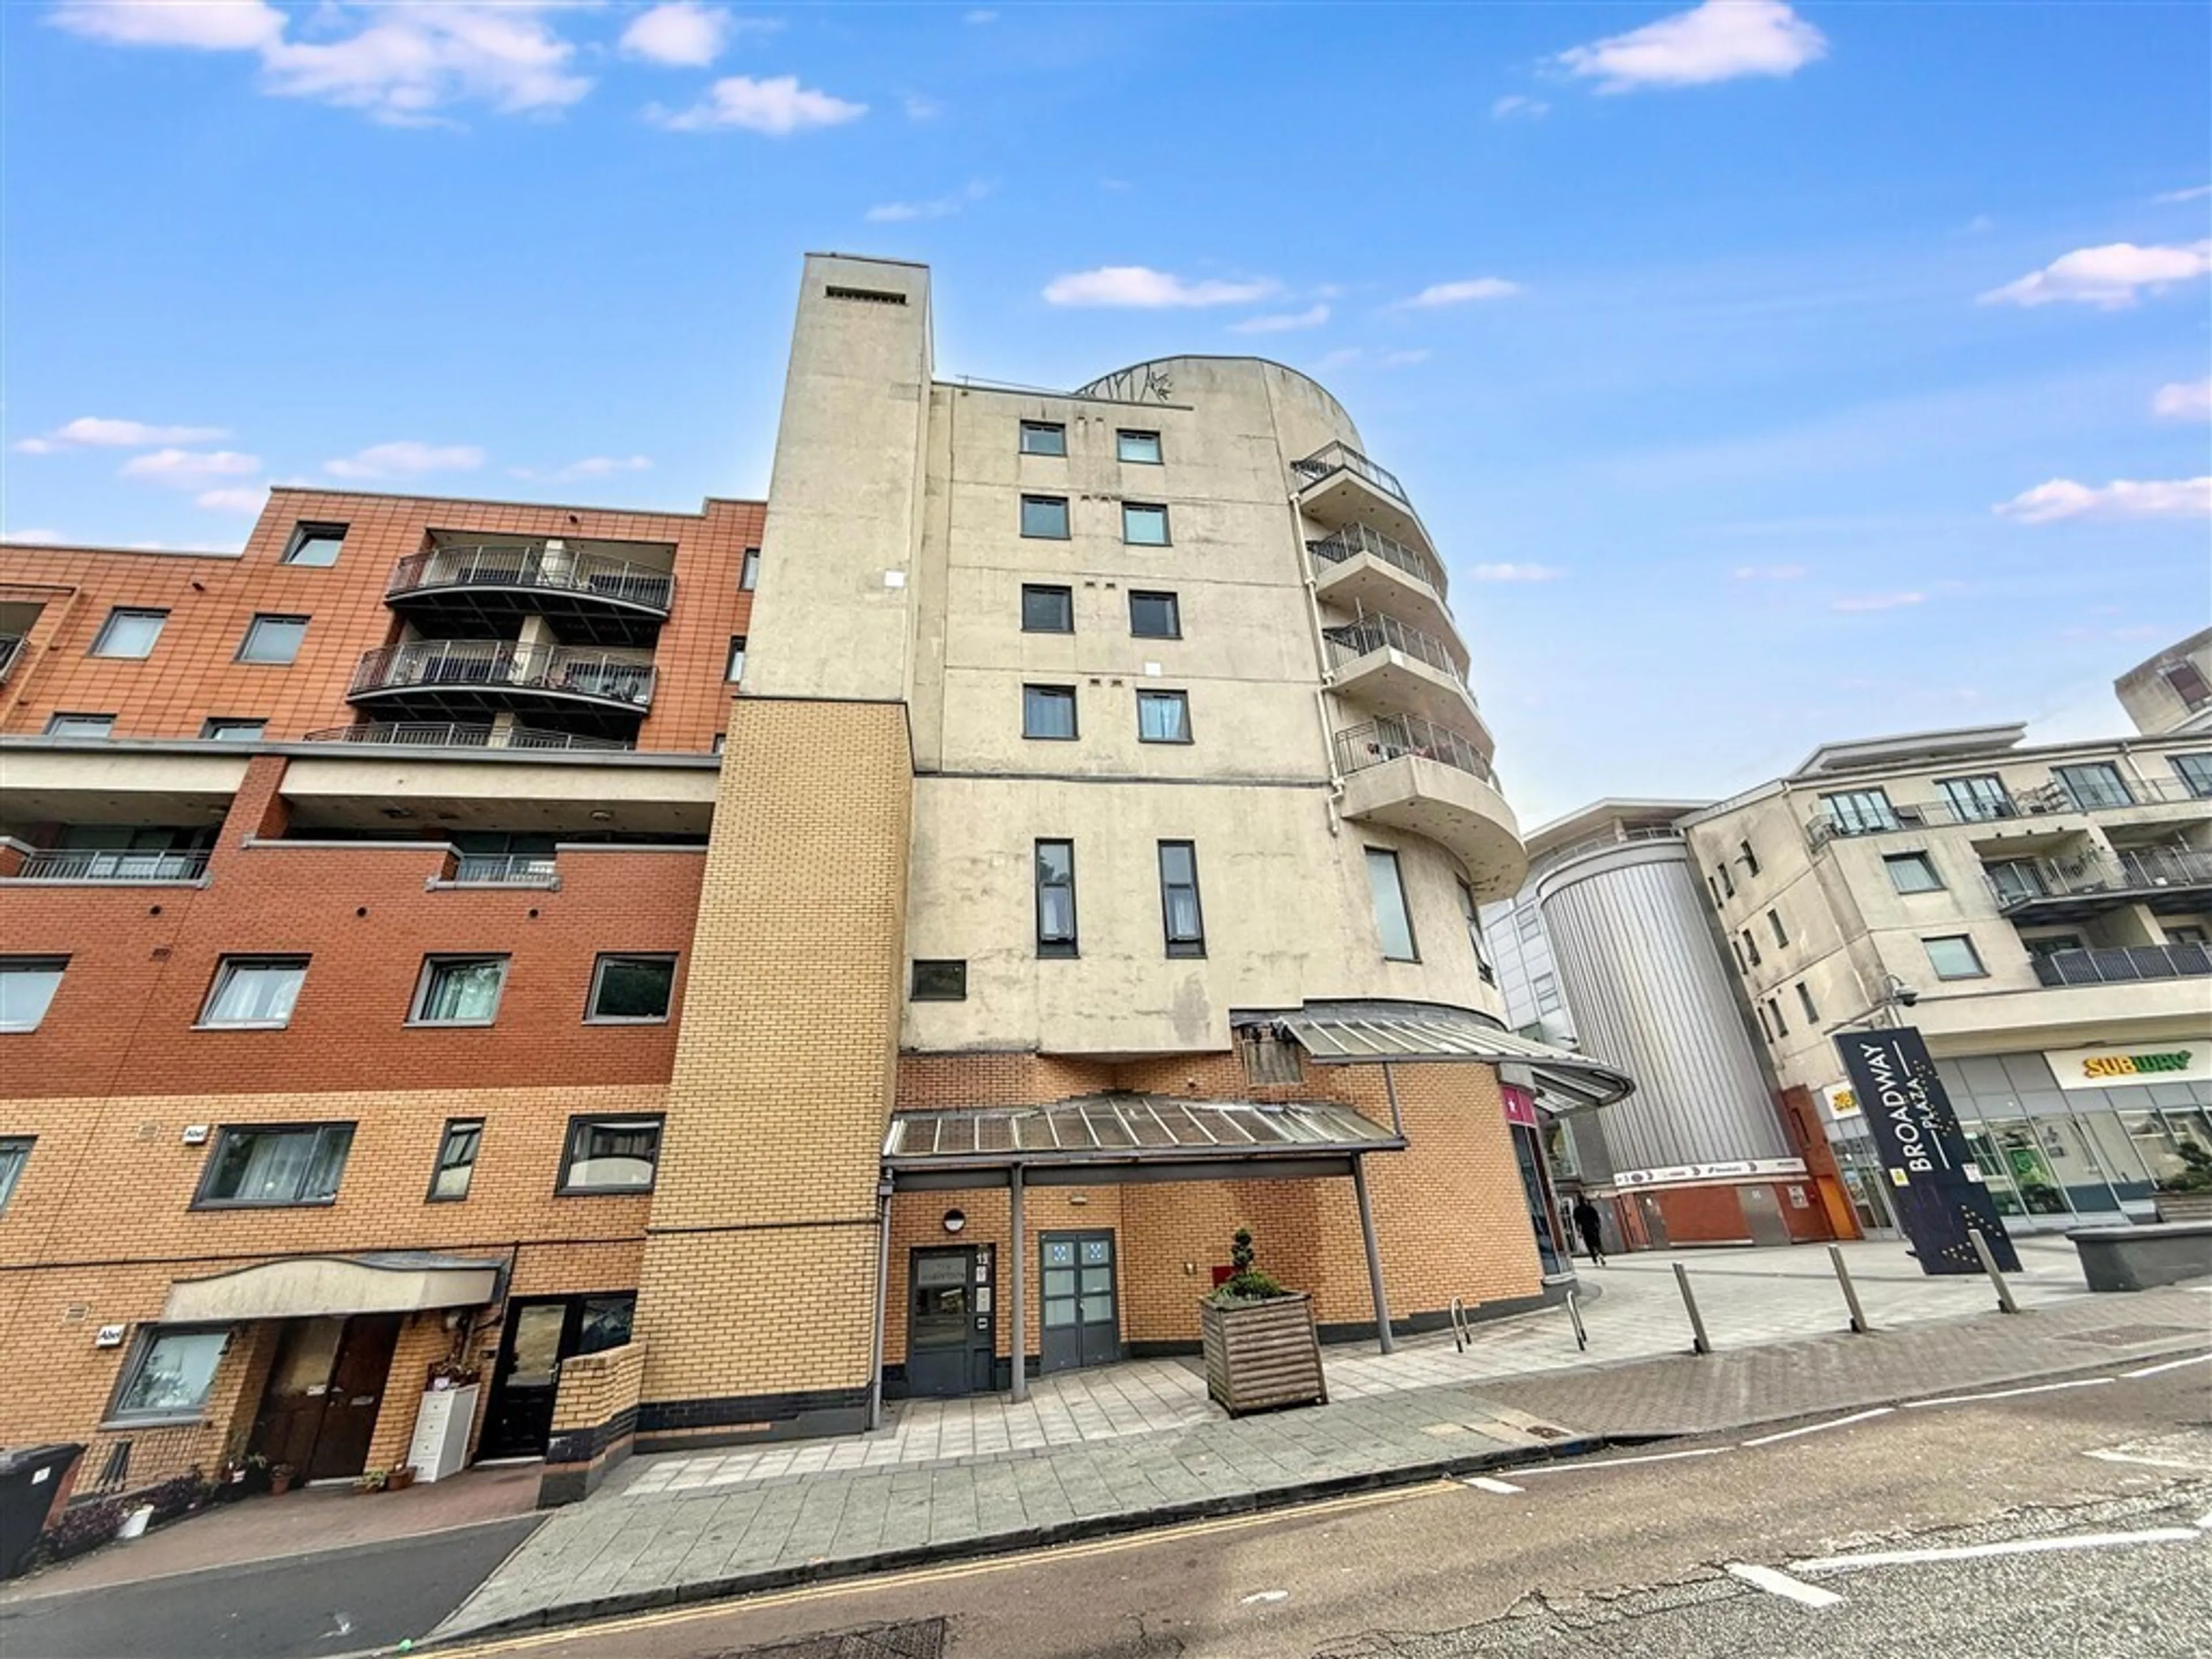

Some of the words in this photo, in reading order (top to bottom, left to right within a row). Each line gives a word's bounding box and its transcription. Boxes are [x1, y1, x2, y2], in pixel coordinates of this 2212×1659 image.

[2082, 1050, 2192, 1078] SUBWAY
[1859, 1043, 1933, 1172] BROADWAY
[1907, 1078, 1938, 1129] PLAZA
